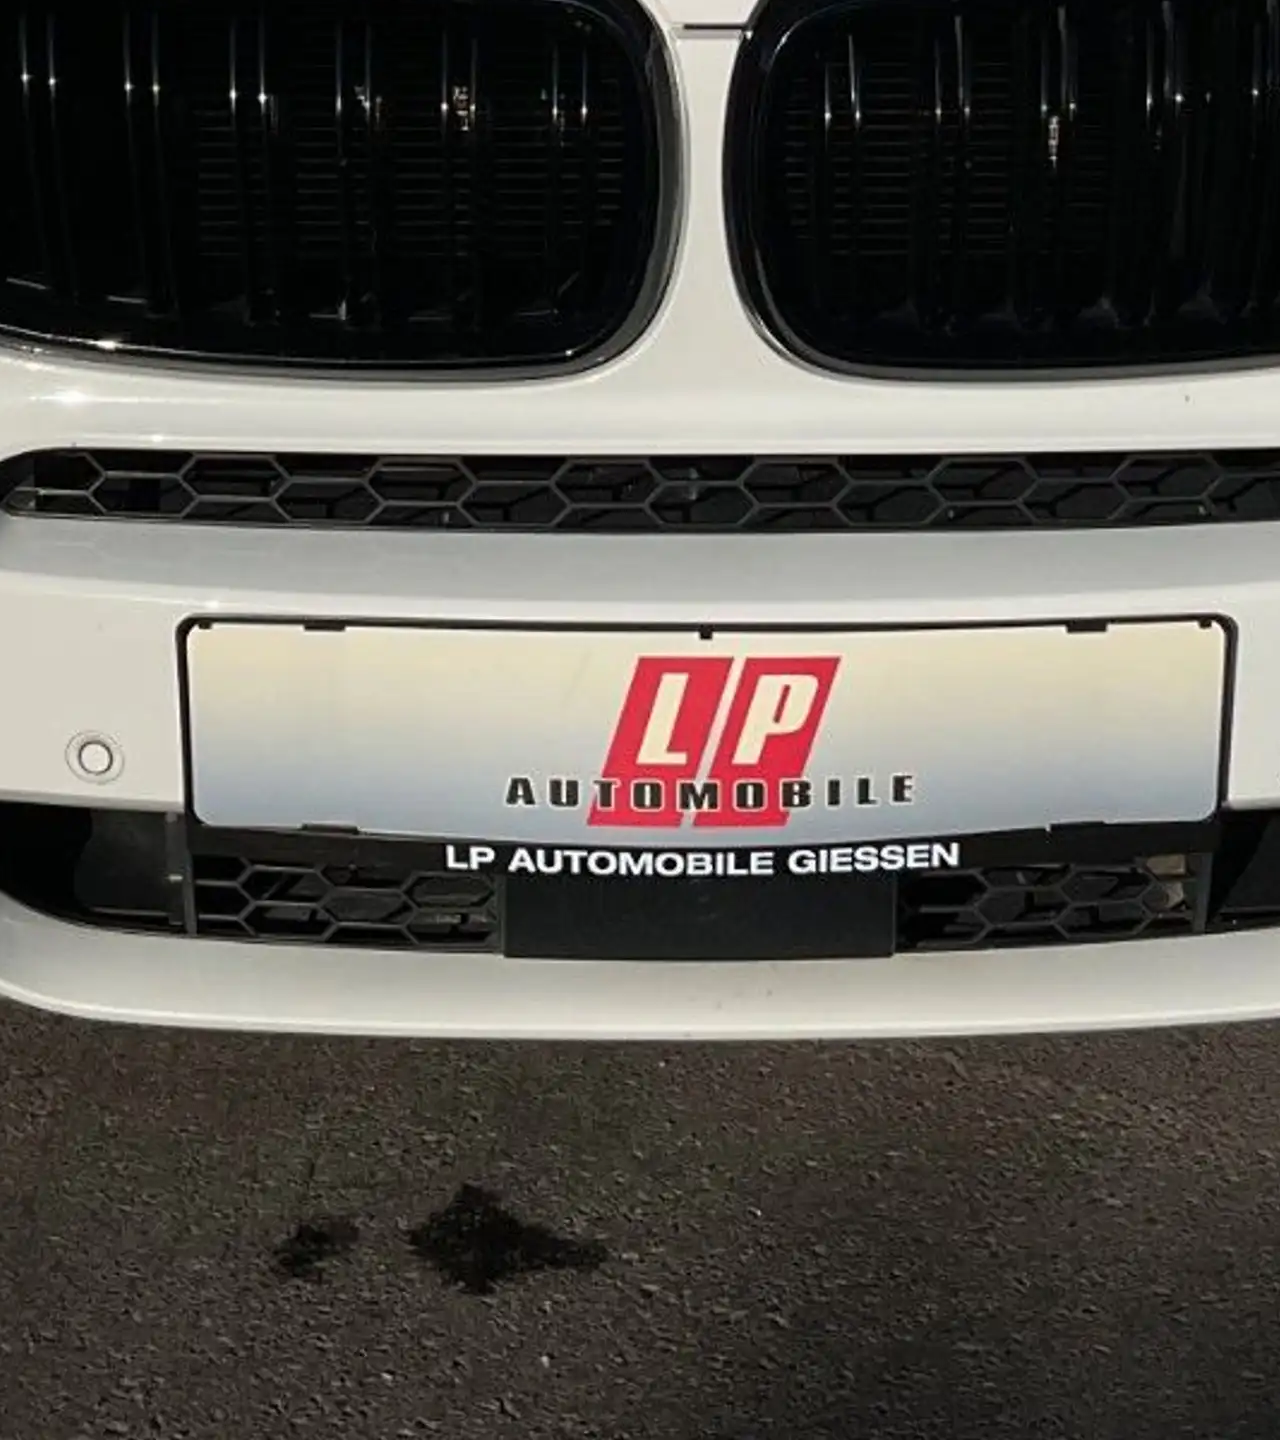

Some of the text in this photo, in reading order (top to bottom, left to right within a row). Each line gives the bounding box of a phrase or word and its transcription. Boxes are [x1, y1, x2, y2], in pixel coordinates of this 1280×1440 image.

[635, 672, 819, 765] LP
[505, 775, 913, 810] AUTOMOBILE
[445, 842, 959, 876] LP AUTOMOBILE GIESSEN
